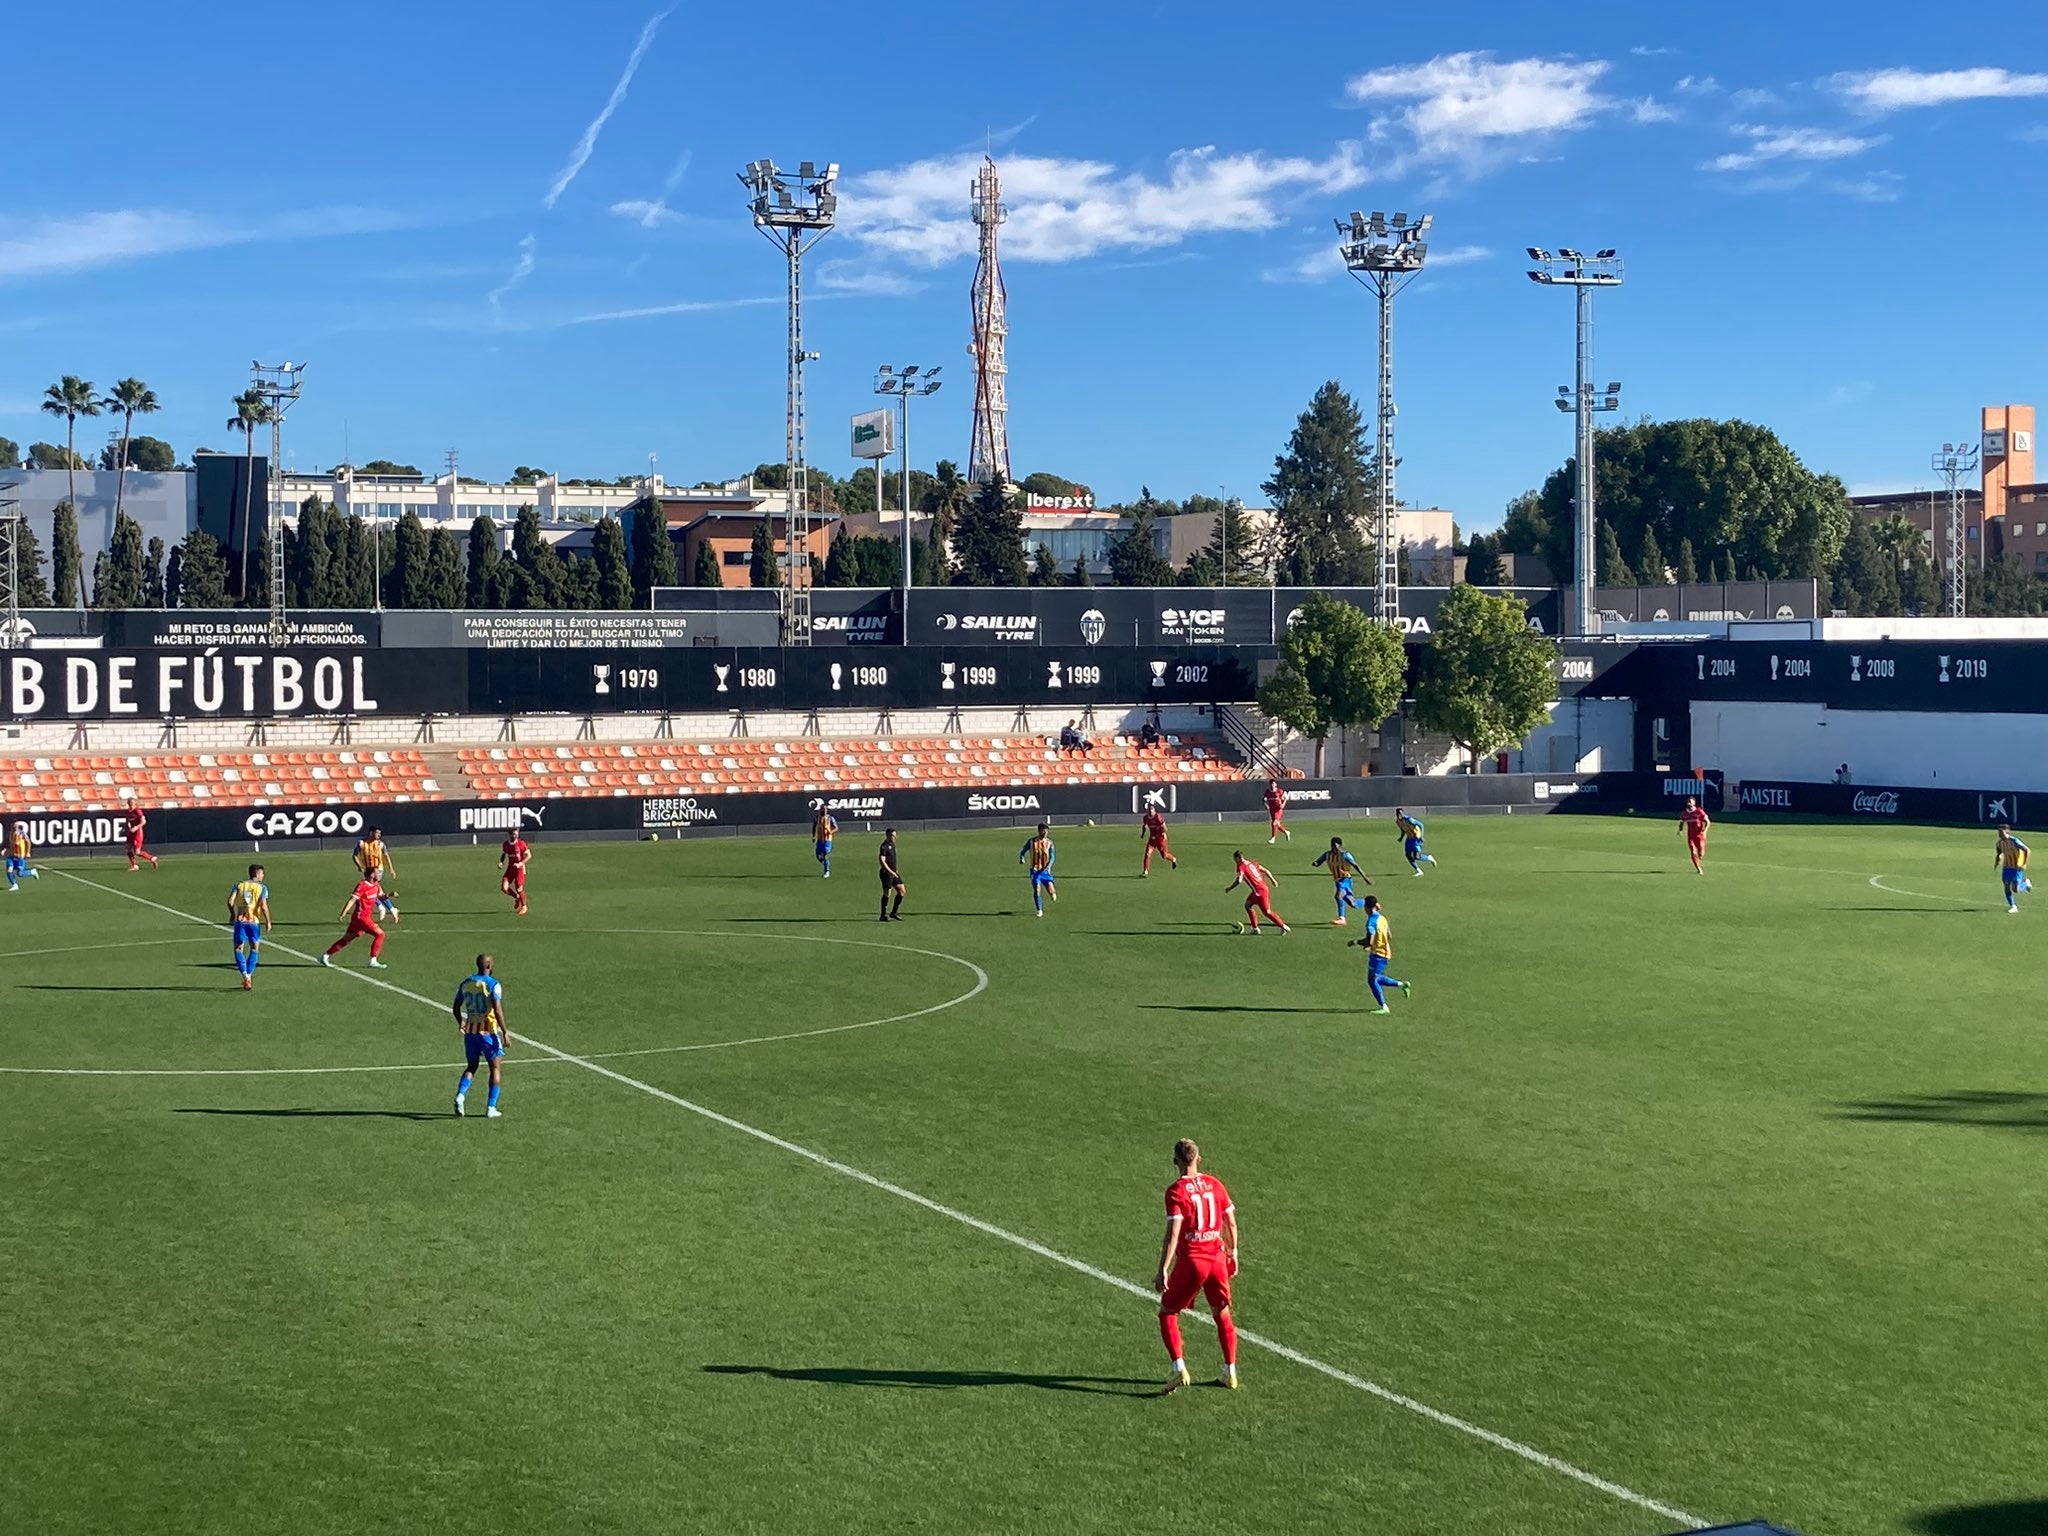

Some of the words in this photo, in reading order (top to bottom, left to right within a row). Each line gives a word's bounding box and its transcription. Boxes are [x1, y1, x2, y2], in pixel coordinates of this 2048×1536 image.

[1027, 492, 1093, 510] Iberext
[169, 624, 182, 634] MI
[184, 624, 214, 634] RETO
[216, 624, 231, 634] ES
[301, 621, 354, 634] AMBICIÓN
[464, 618, 492, 628] PARA
[494, 618, 553, 628] CONSEGUIR
[555, 618, 568, 628] EL
[569, 616, 599, 628] ÉXITO
[600, 618, 654, 628] NECESITAS
[656, 619, 687, 628] TENER
[812, 616, 887, 631] SAILUN
[961, 615, 1037, 630] SAILUN
[1161, 627, 1184, 635] FAN
[1187, 627, 1225, 635] TOKEN
[154, 635, 192, 645] HACER
[194, 635, 256, 645] DISFRUTAR
[258, 635, 267, 645] A
[293, 635, 367, 645] AFICIONADOS.
[468, 629, 489, 638] UNA
[491, 628, 553, 638] DEDICACIÓN
[554, 629, 589, 639] TOTAL,
[591, 629, 632, 638] BUSCAR
[633, 629, 646, 638] TU
[648, 628, 684, 638] ÚLTIMO
[845, 632, 885, 641] TYRE
[995, 631, 1035, 640] TYRE
[487, 638, 519, 648] LÍMITE
[521, 639, 529, 648] Y
[530, 639, 551, 648] DAR
[553, 639, 567, 648] LO
[569, 639, 603, 648] MEJOR
[604, 639, 619, 648] DE
[620, 639, 630, 648] TI
[631, 639, 665, 648] MISMO.
[851, 666, 888, 686] 1980
[961, 666, 997, 686] 1999
[1066, 665, 1101, 685] 1999
[1175, 665, 1209, 683] 2002
[1562, 661, 1594, 679] 2004
[1710, 659, 1736, 677] 2004
[1784, 659, 1812, 677] 2004
[1866, 659, 1896, 678] 2008
[1956, 659, 1988, 679] 2019
[66, 656, 138, 714] DE
[159, 646, 378, 714] FÚTBOL
[619, 669, 659, 688] 1979
[738, 668, 777, 687] 1980
[642, 798, 698, 811] HERRERO
[827, 797, 885, 810] SAILUN
[967, 793, 1041, 811] ŠKODA
[1741, 787, 1793, 807] AMSTEL
[460, 807, 522, 830] PUMA
[642, 808, 718, 821] BRIGANTINA
[852, 809, 883, 818] TYRE
[245, 810, 364, 836] CAZOO
[1191, 1191, 1216, 1231] 11
